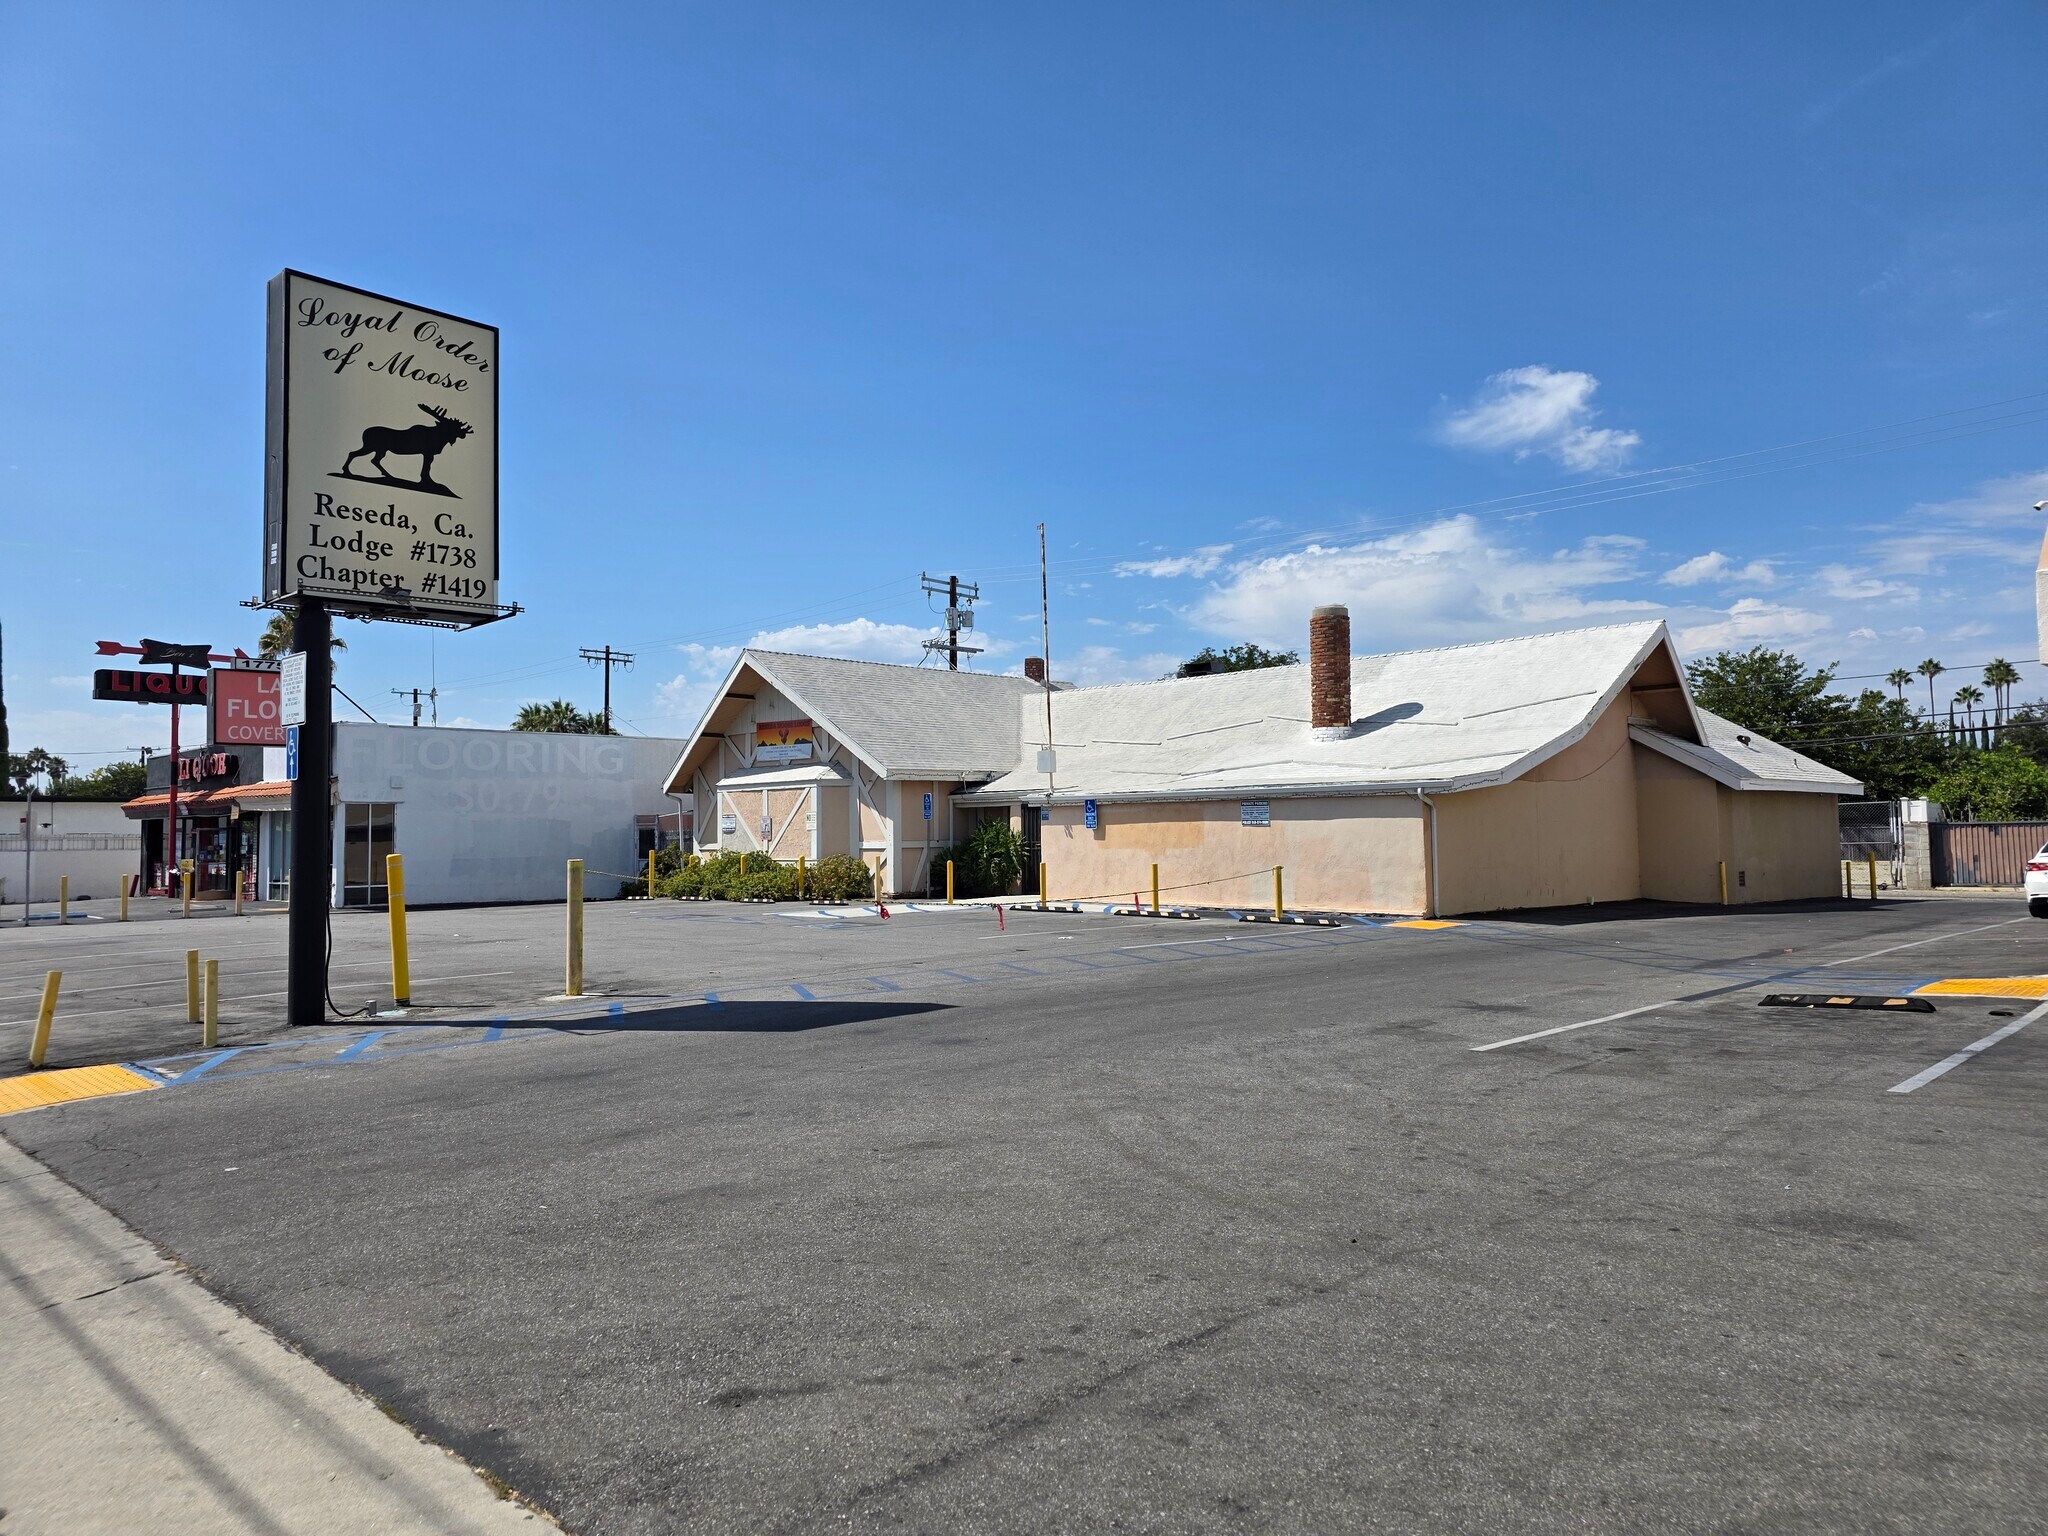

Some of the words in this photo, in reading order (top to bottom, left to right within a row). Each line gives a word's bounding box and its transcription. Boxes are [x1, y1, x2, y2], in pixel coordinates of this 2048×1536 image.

[298, 297, 404, 338] Loyal
[413, 321, 490, 373] Order
[322, 342, 364, 374] of
[367, 352, 470, 392] Moose
[313, 492, 418, 534] Reseda,
[434, 513, 474, 539] Ca.
[309, 523, 394, 561] Lodge
[410, 540, 477, 569] #1738
[297, 554, 405, 591] Chapter
[421, 572, 487, 600] #1419
[227, 698, 283, 720] FLO
[343, 734, 624, 775] FLOORING
